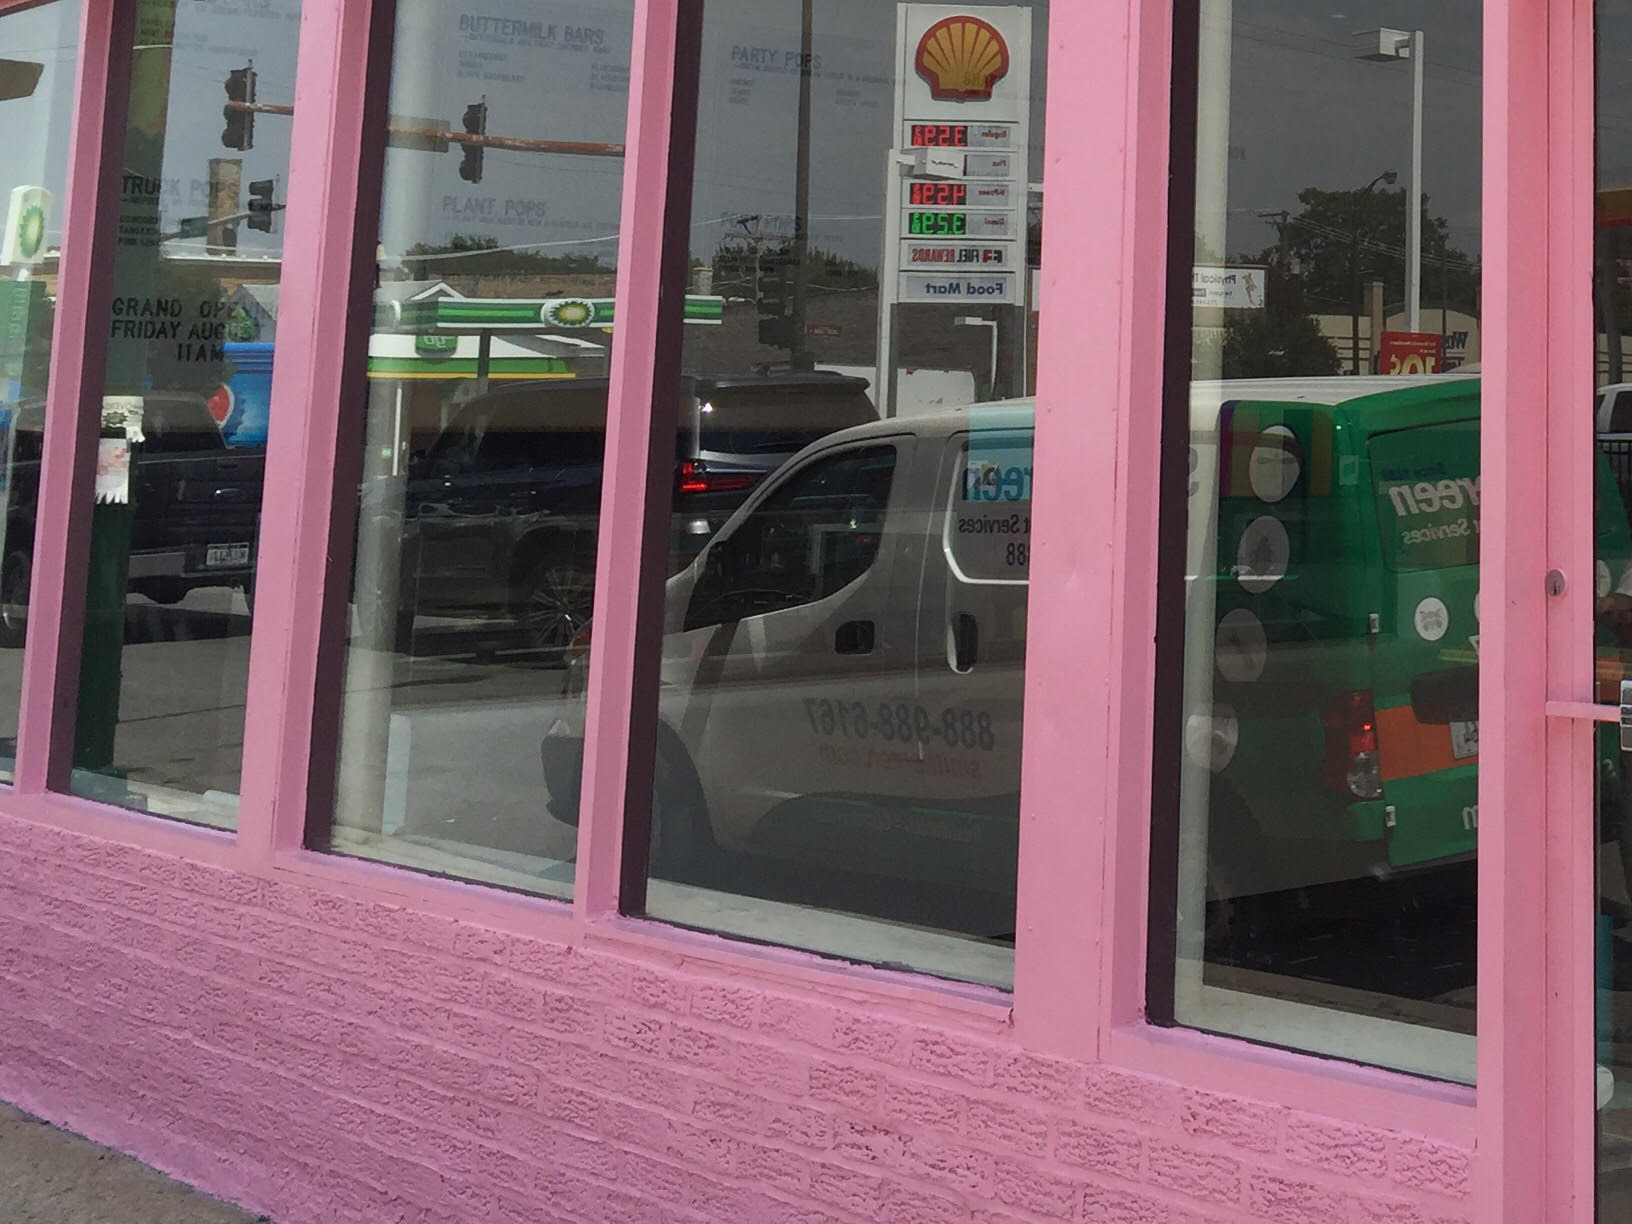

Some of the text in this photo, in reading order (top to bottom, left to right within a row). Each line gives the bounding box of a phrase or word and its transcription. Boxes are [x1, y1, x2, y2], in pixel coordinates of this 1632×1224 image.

[458, 13, 558, 40] BUTTERMILK
[563, 24, 606, 45] BARS
[730, 45, 778, 63] PARTY
[442, 195, 547, 218] PLANT POPS
[111, 297, 183, 318] GRAND
[109, 319, 182, 340] FRIDAY
